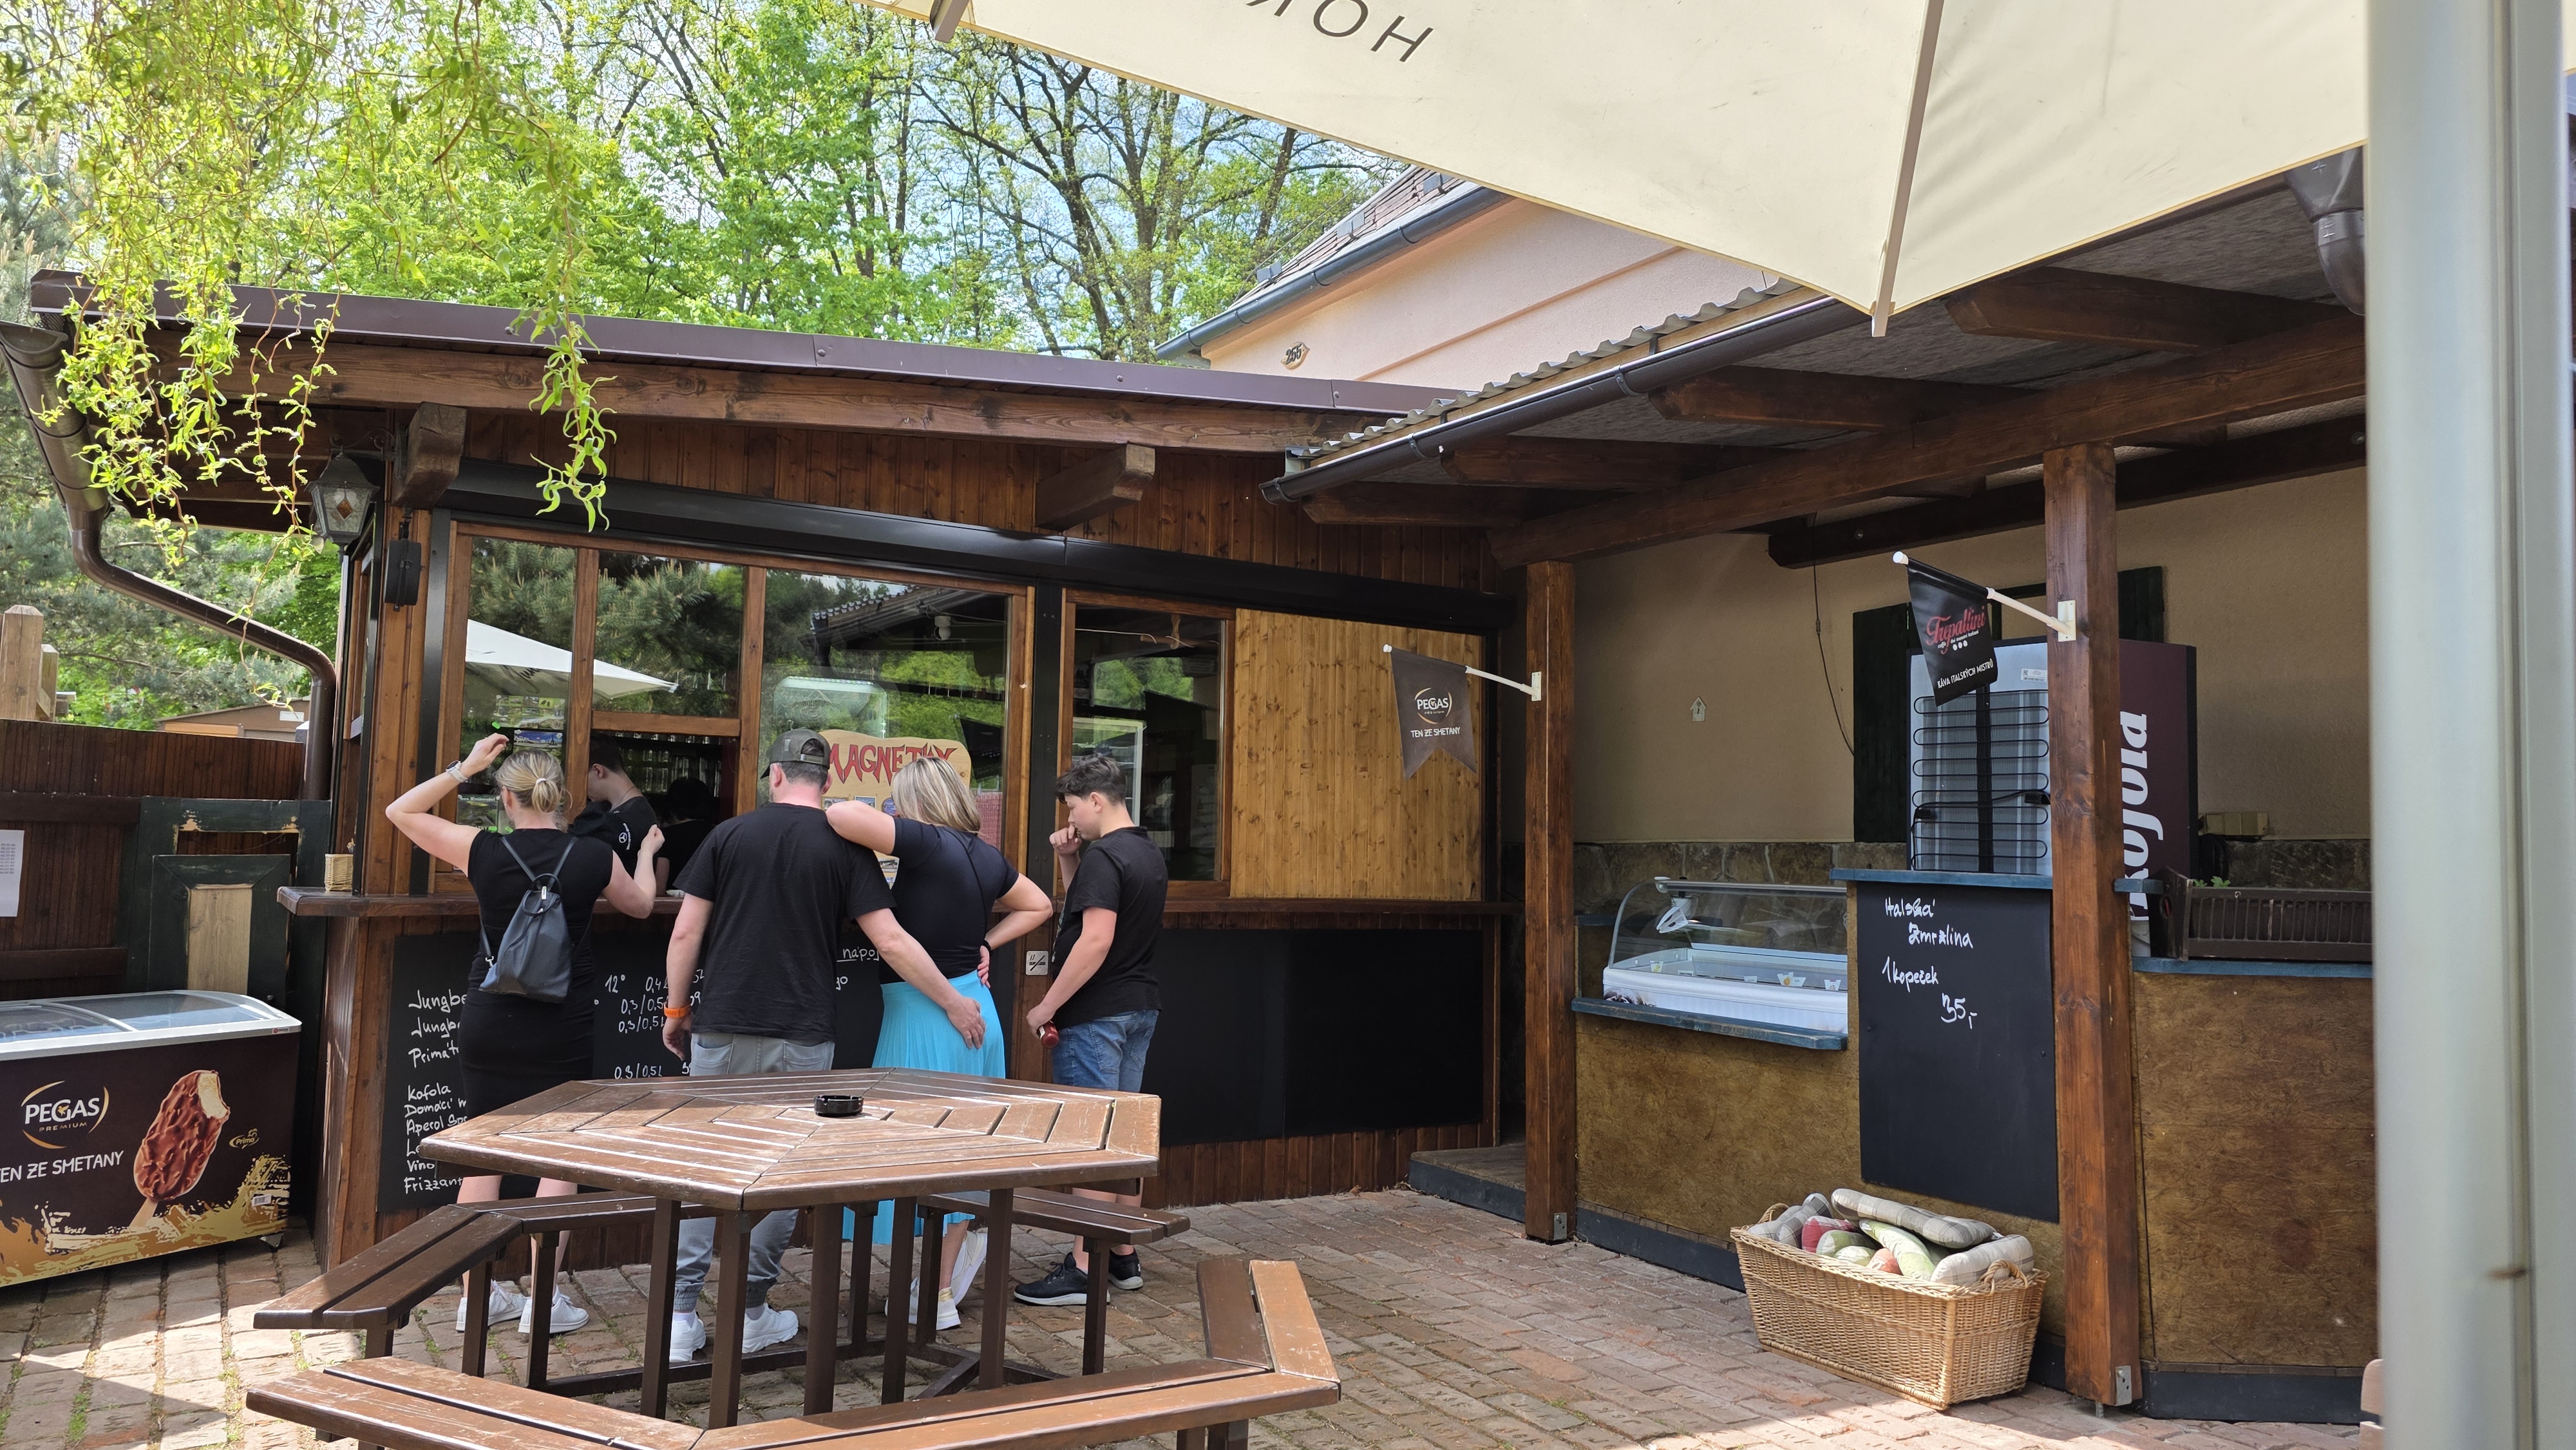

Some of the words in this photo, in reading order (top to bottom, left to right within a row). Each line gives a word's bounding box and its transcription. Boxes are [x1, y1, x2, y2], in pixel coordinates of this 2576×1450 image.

[1285, 344, 1302, 365] 255
[1937, 678, 1951, 689] KÁVA
[1951, 667, 1976, 684] ITALSKÝCH
[1976, 658, 1994, 673] MISTRŮ
[1417, 697, 1449, 710] PEGAS
[1410, 730, 1423, 738] TEN
[1434, 726, 1461, 737] SMETANY
[1885, 896, 1935, 918] Italská
[1882, 956, 1891, 983] 1
[410, 1016, 460, 1039] Jungb
[408, 1082, 451, 1102] Kofola
[24, 1097, 100, 1125] PEGAS
[404, 1098, 453, 1118] Domácí
[39, 1122, 88, 1133] PREMIUM
[236, 1137, 255, 1145] Prima
[0, 1167, 23, 1183] EN
[26, 1161, 48, 1180] ZE
[52, 1150, 124, 1176] SMETANY
